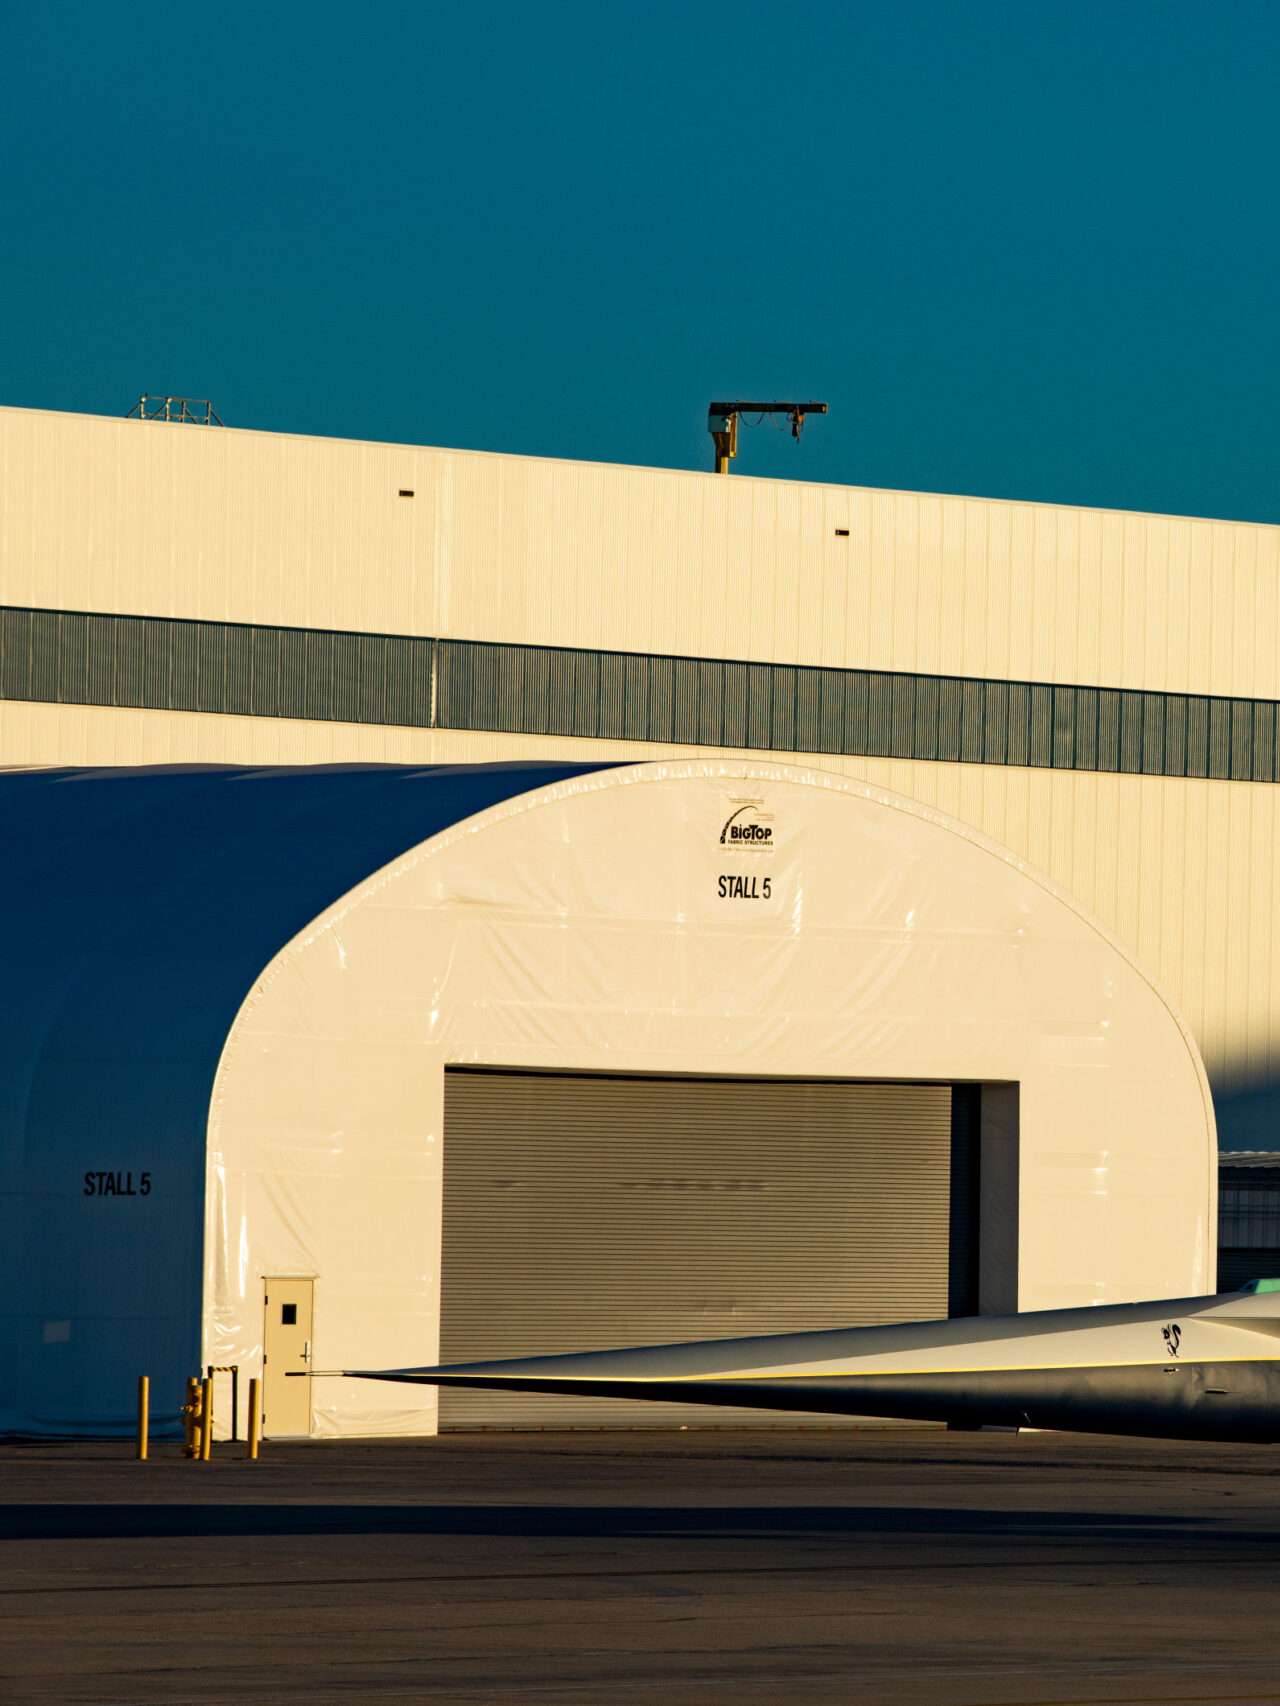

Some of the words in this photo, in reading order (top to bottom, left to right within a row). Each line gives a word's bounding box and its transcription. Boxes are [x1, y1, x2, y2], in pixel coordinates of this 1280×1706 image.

[718, 875, 759, 899] STALL
[763, 877, 772, 899] 5
[84, 1172, 136, 1196] STALL
[140, 1172, 151, 1196] 5
